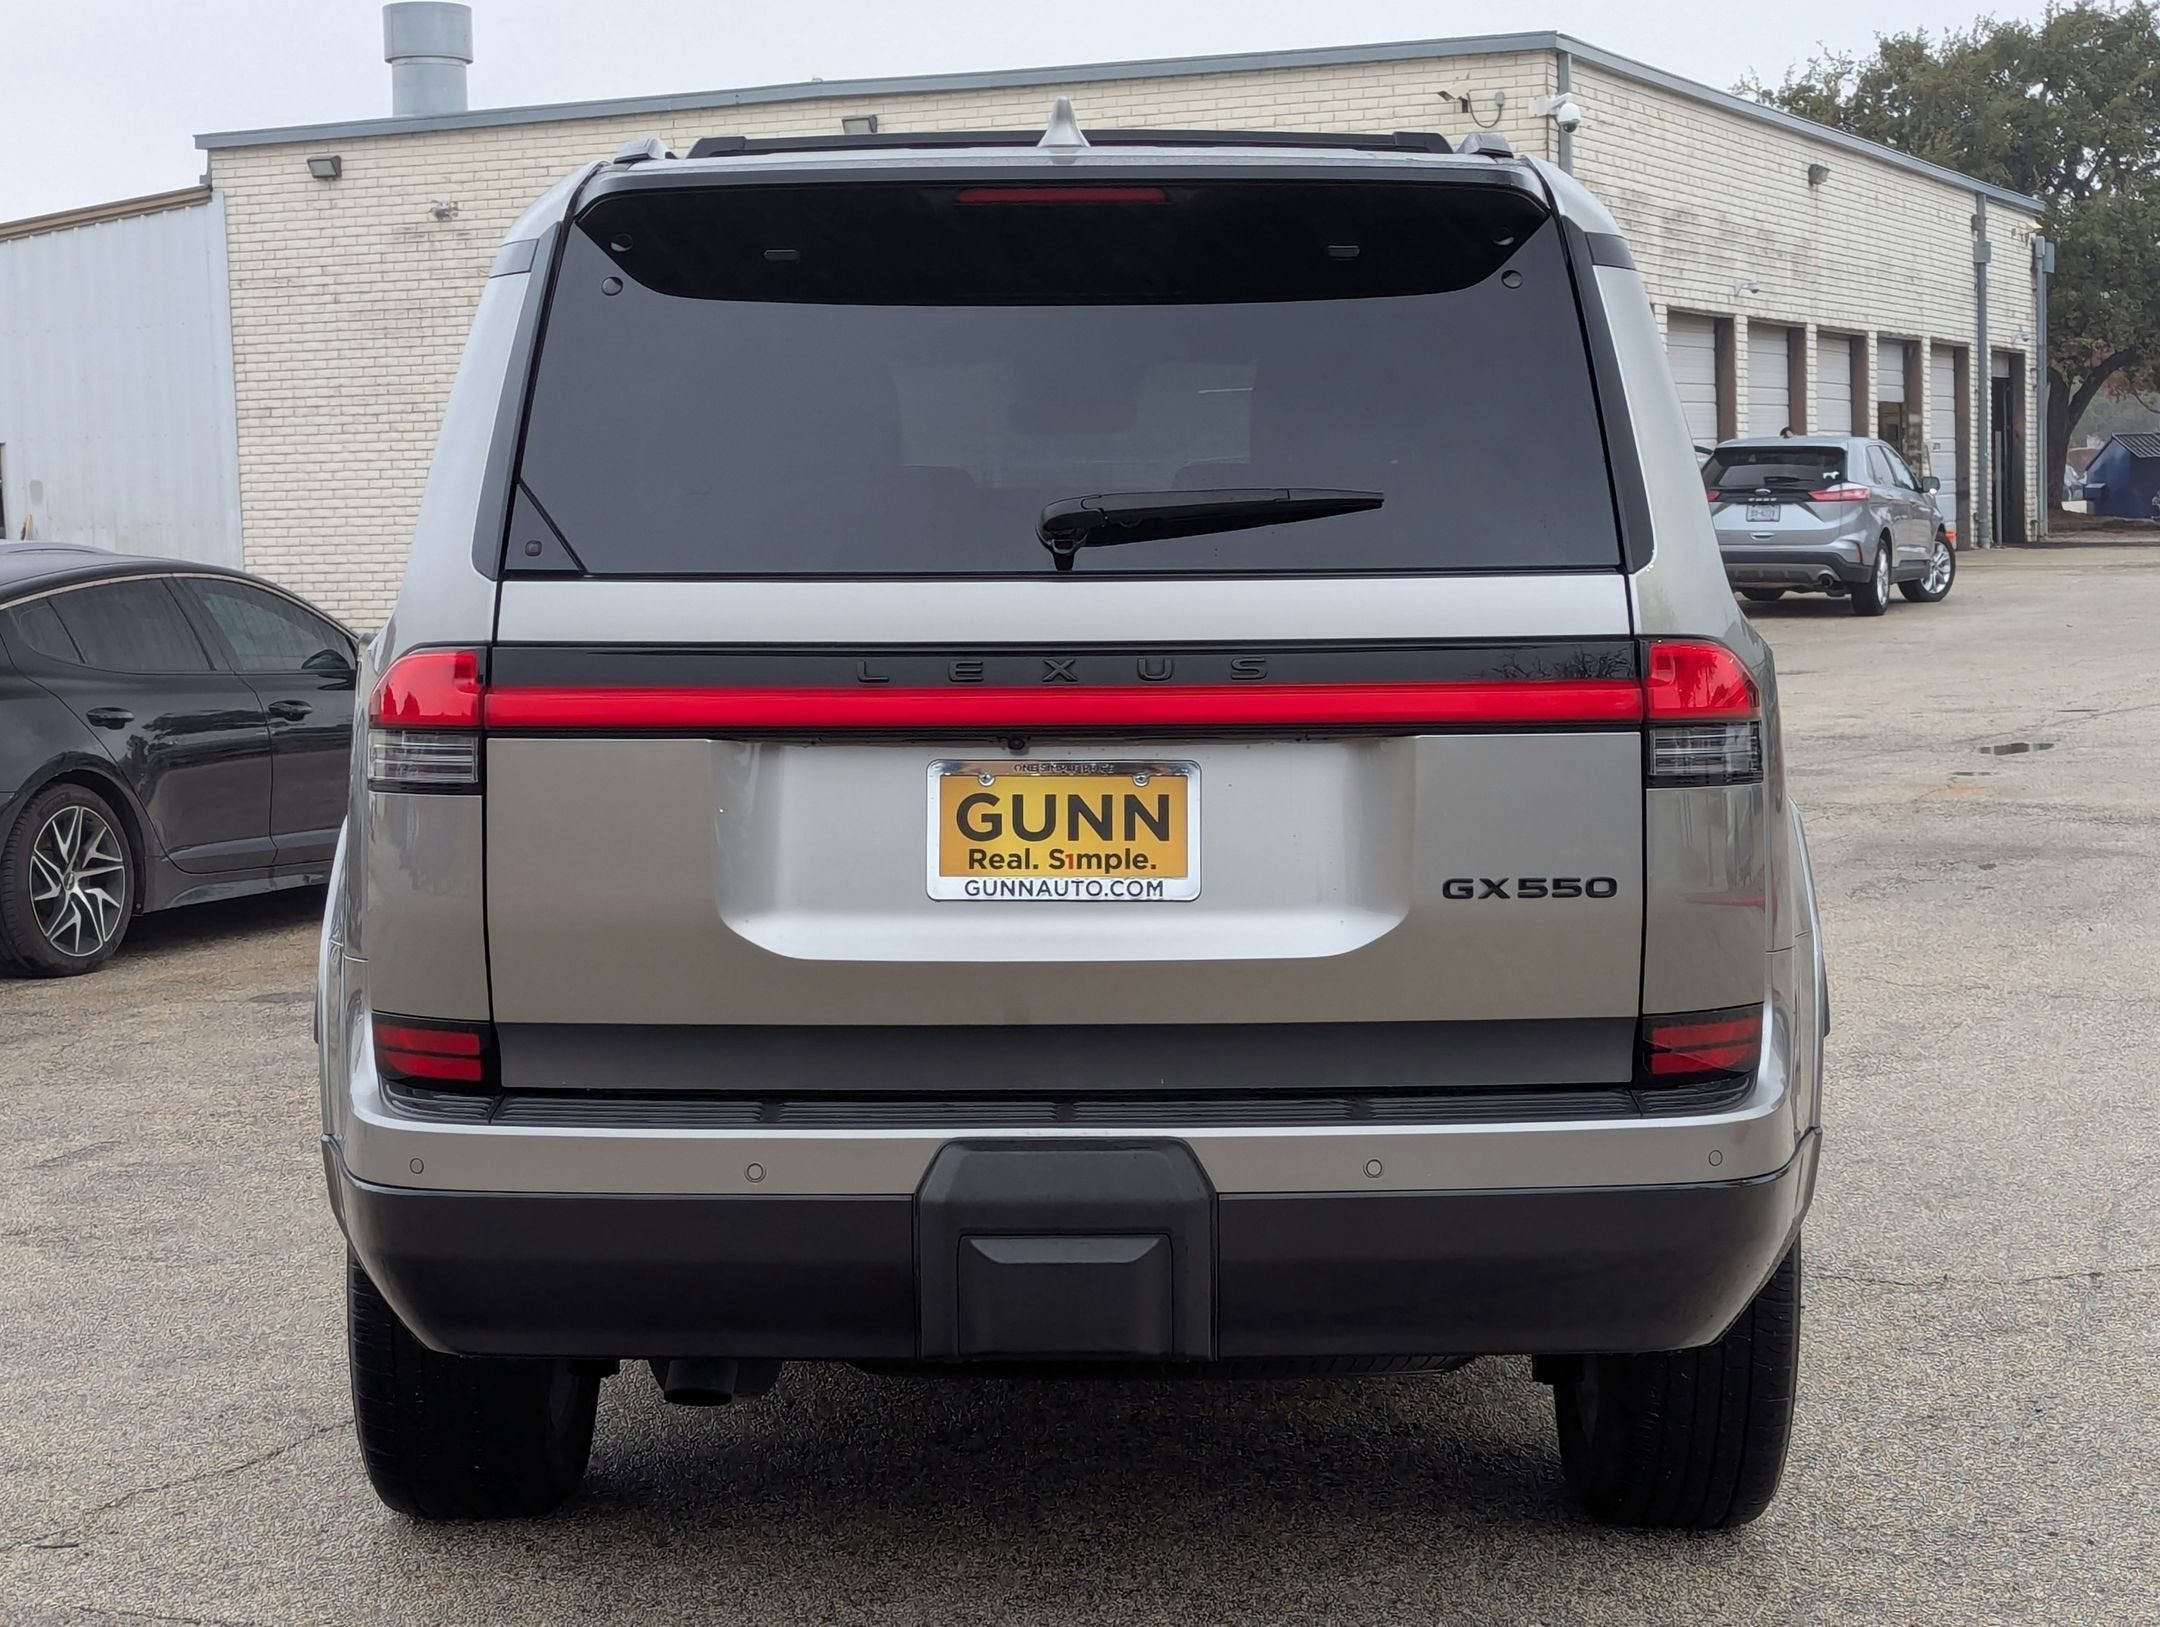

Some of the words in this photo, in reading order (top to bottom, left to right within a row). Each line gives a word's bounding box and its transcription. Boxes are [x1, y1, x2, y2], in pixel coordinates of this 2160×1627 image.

[857, 658, 1268, 684] LEXUS
[956, 793, 1170, 842] GUNN
[969, 848, 1039, 870] Real.
[964, 880, 1164, 897] GUNNAUTO.COM
